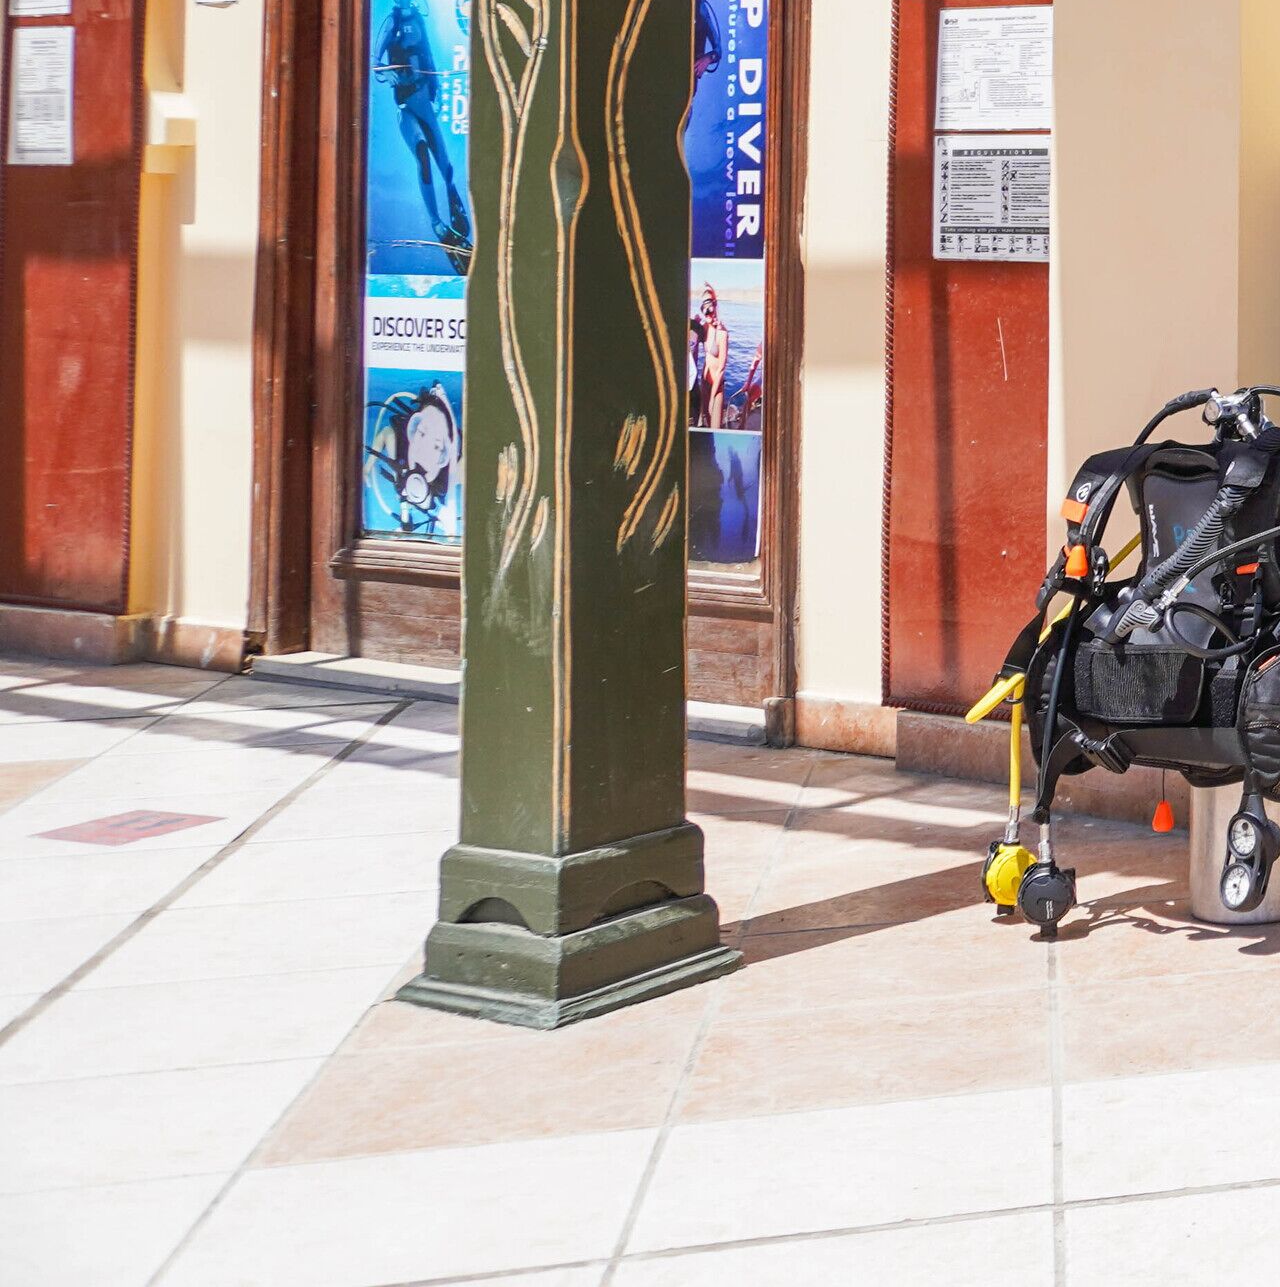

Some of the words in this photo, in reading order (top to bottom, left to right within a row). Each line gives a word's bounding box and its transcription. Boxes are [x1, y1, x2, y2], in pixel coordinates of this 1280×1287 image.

[727, 73, 737, 97] to
[726, 107, 735, 121] a
[725, 131, 735, 182] new
[736, 58, 763, 239] DIVER
[373, 316, 444, 338] DISCOVER
